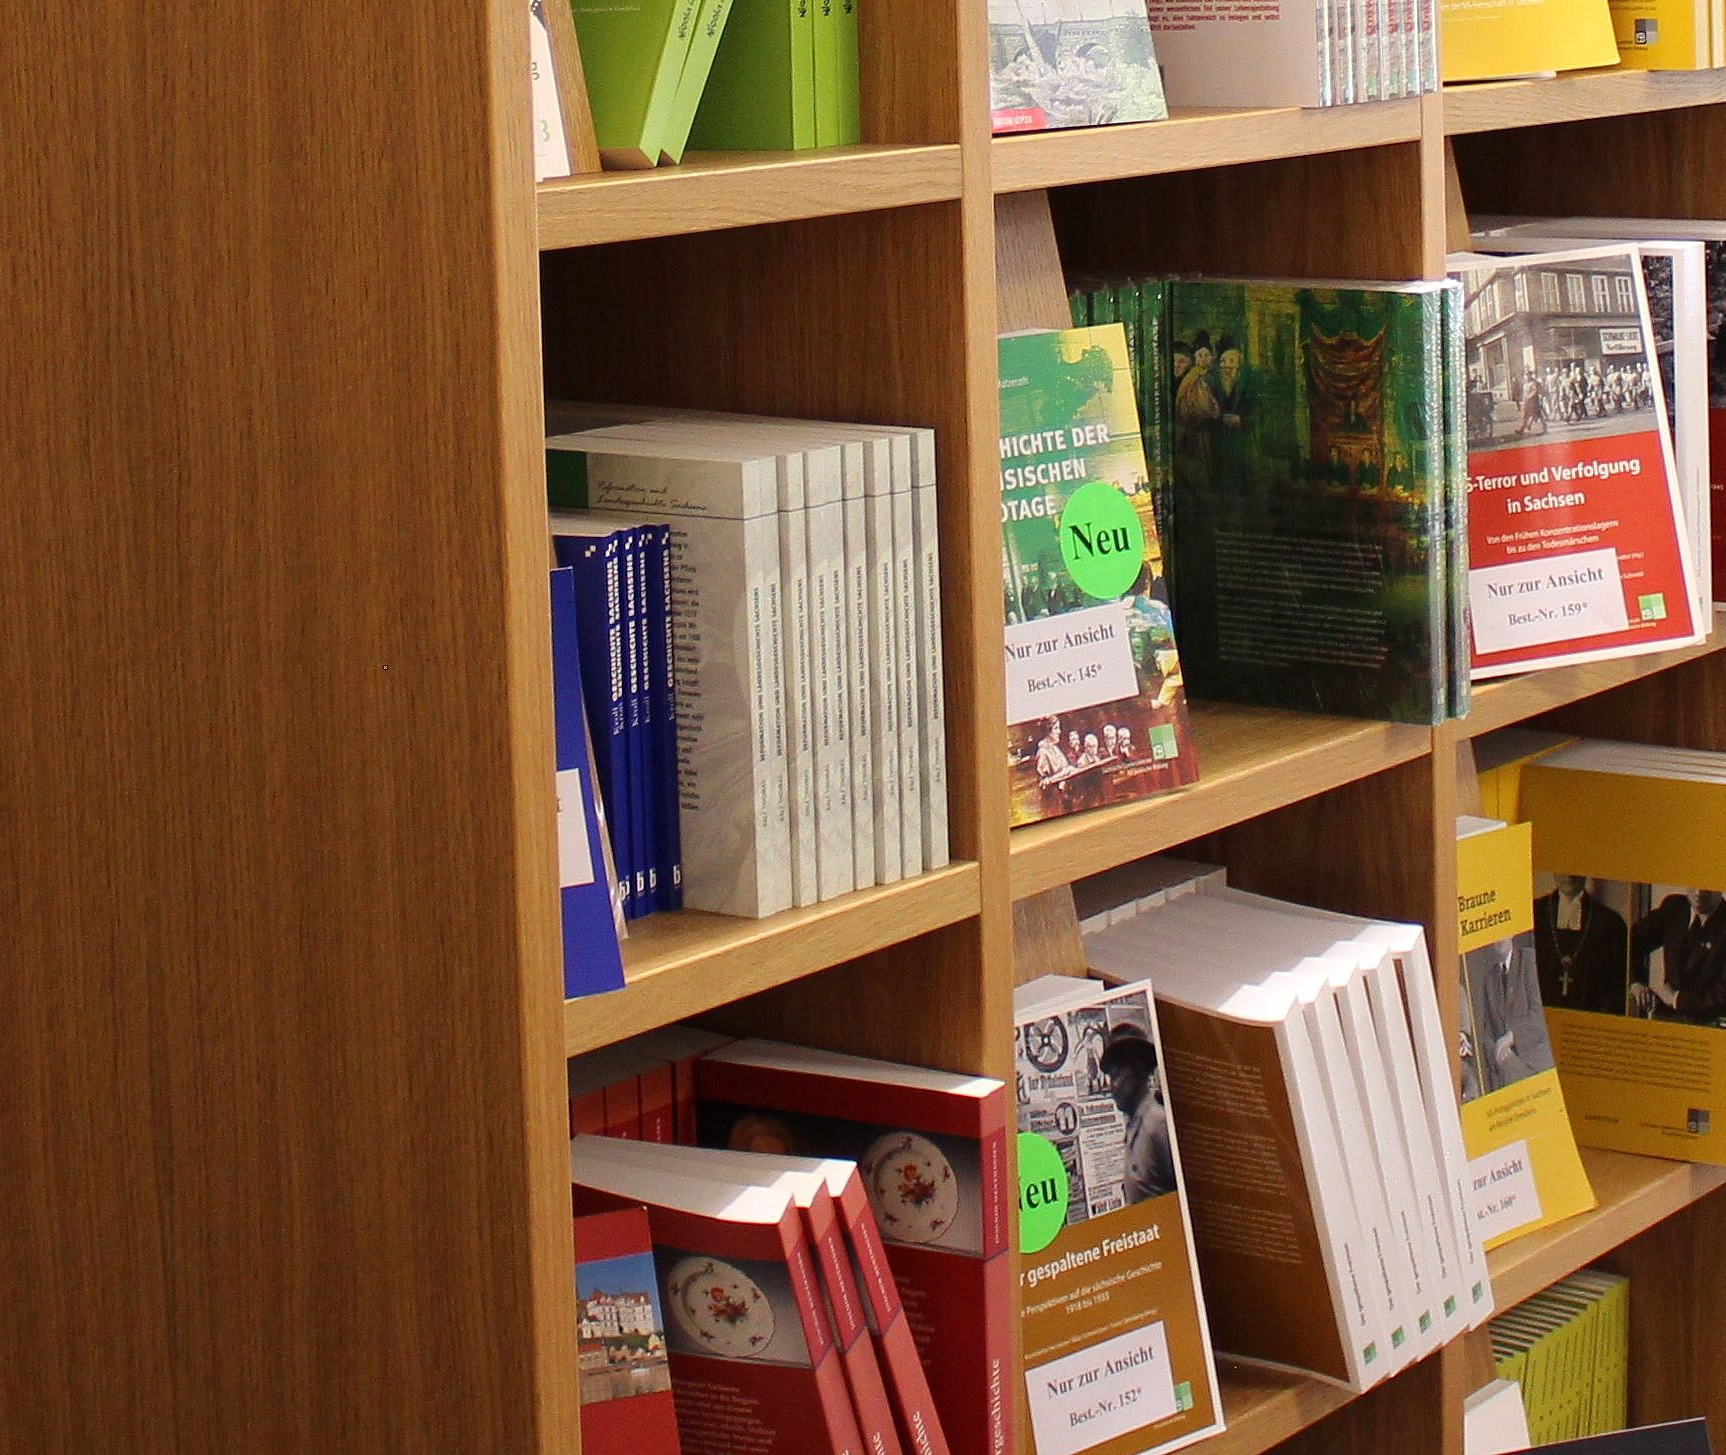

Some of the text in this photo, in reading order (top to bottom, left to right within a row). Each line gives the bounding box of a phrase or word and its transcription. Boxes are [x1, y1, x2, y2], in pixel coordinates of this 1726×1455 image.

[1072, 423, 1110, 449] DER
[1521, 459, 1641, 486] und Verfolgung
[1507, 492, 1585, 514] in Sachsen
[1069, 521, 1131, 561] Neu
[639, 550, 647, 614] SACHSENS
[663, 547, 671, 611] SACHSENS
[1487, 568, 1604, 599] Nur zur Ansicht
[606, 561, 617, 701] GESCHICHTE SACHSENS
[626, 553, 638, 694] GESCHICHTE SACHSENS
[1508, 609, 1558, 626] Best.-Nr.
[1034, 638, 1059, 656] zur
[1063, 622, 1116, 652] Ansicht
[1027, 670, 1076, 694] Best.-Nr.
[1457, 886, 1496, 913] Braune
[1459, 906, 1512, 937] Karrieren
[1489, 1156, 1524, 1185] Ansicht
[1027, 1224, 1161, 1287] gespaltene Freistaat
[1047, 1345, 1155, 1400] Nur zur Ansicht
[1069, 1400, 1117, 1426] Best.-Nr.
